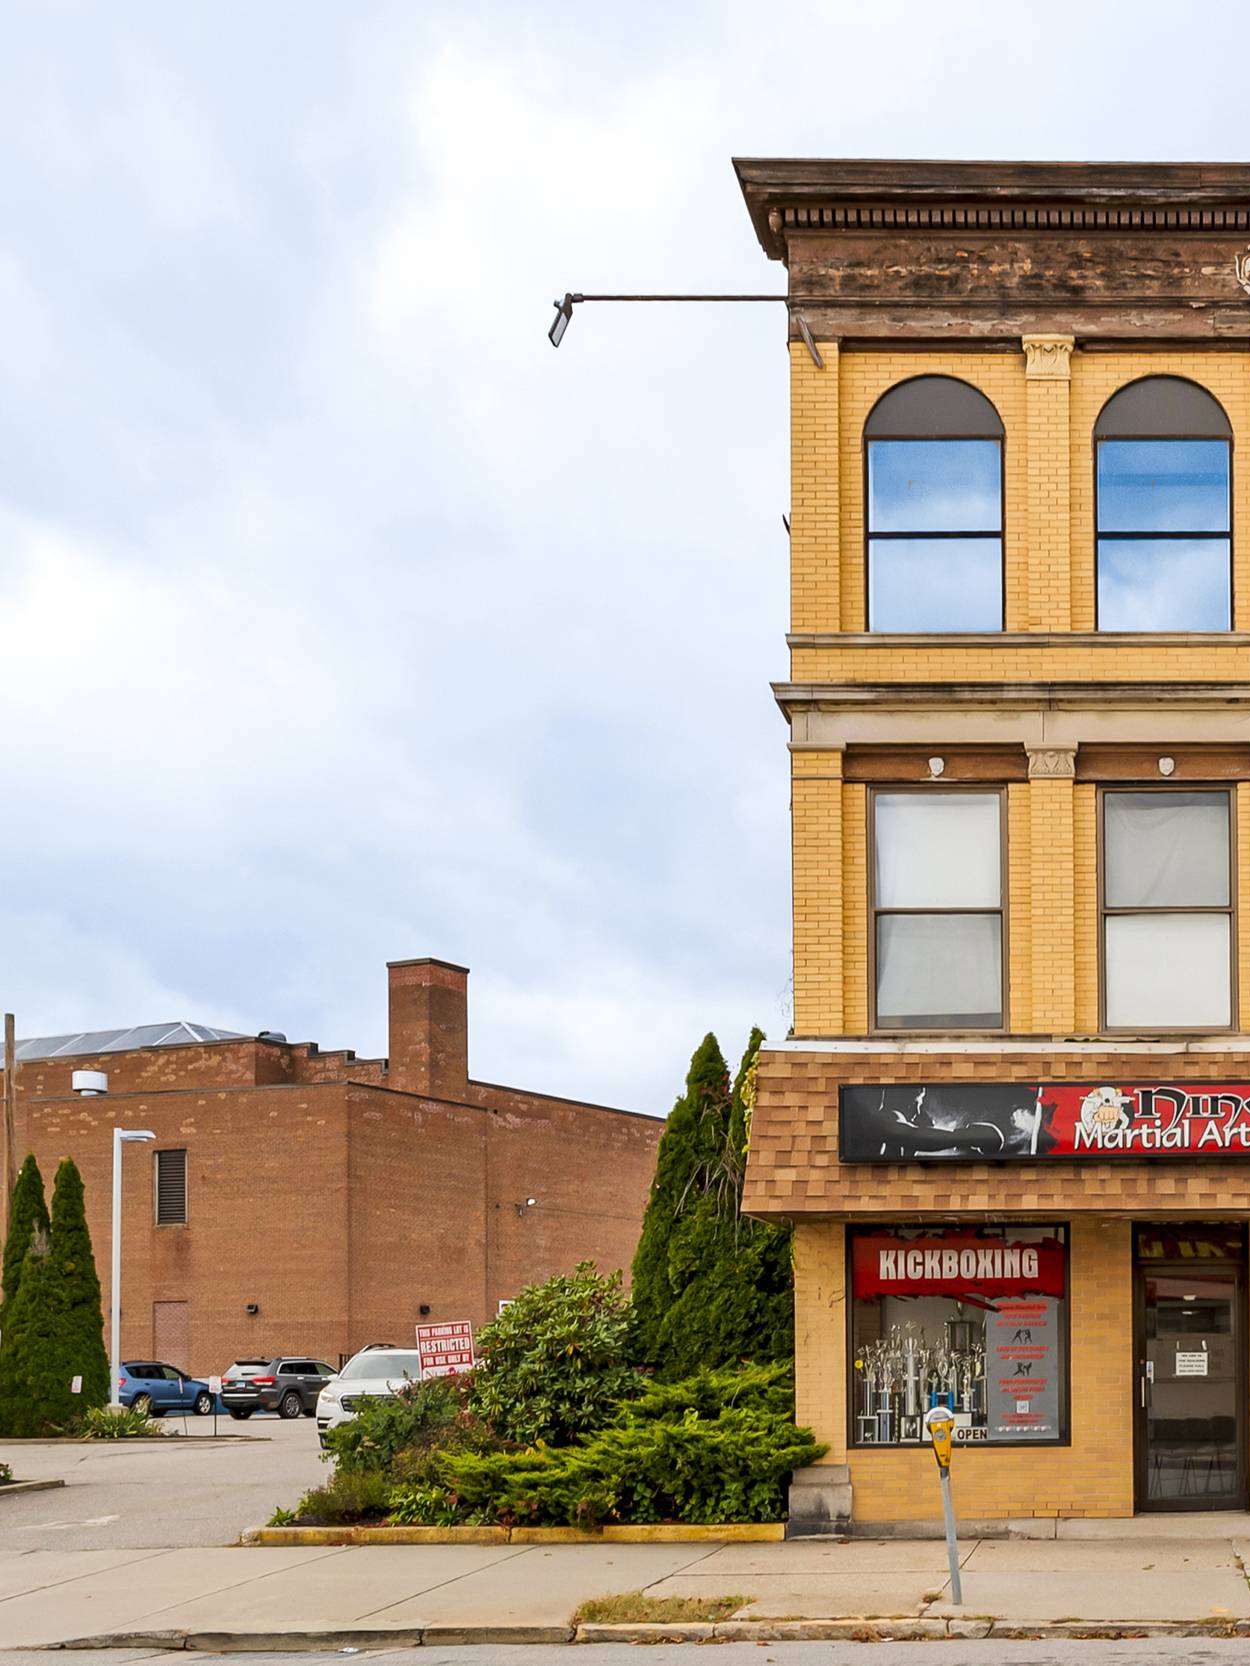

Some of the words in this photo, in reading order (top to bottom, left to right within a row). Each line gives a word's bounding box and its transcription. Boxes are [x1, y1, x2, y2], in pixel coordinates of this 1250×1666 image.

[1073, 1117, 1190, 1150] Martial
[878, 1248, 1040, 1281] KICKBOXING
[431, 1326, 452, 1336] PARKING
[420, 1337, 470, 1353] RESTRICTED
[957, 1429, 988, 1440] OPEN
